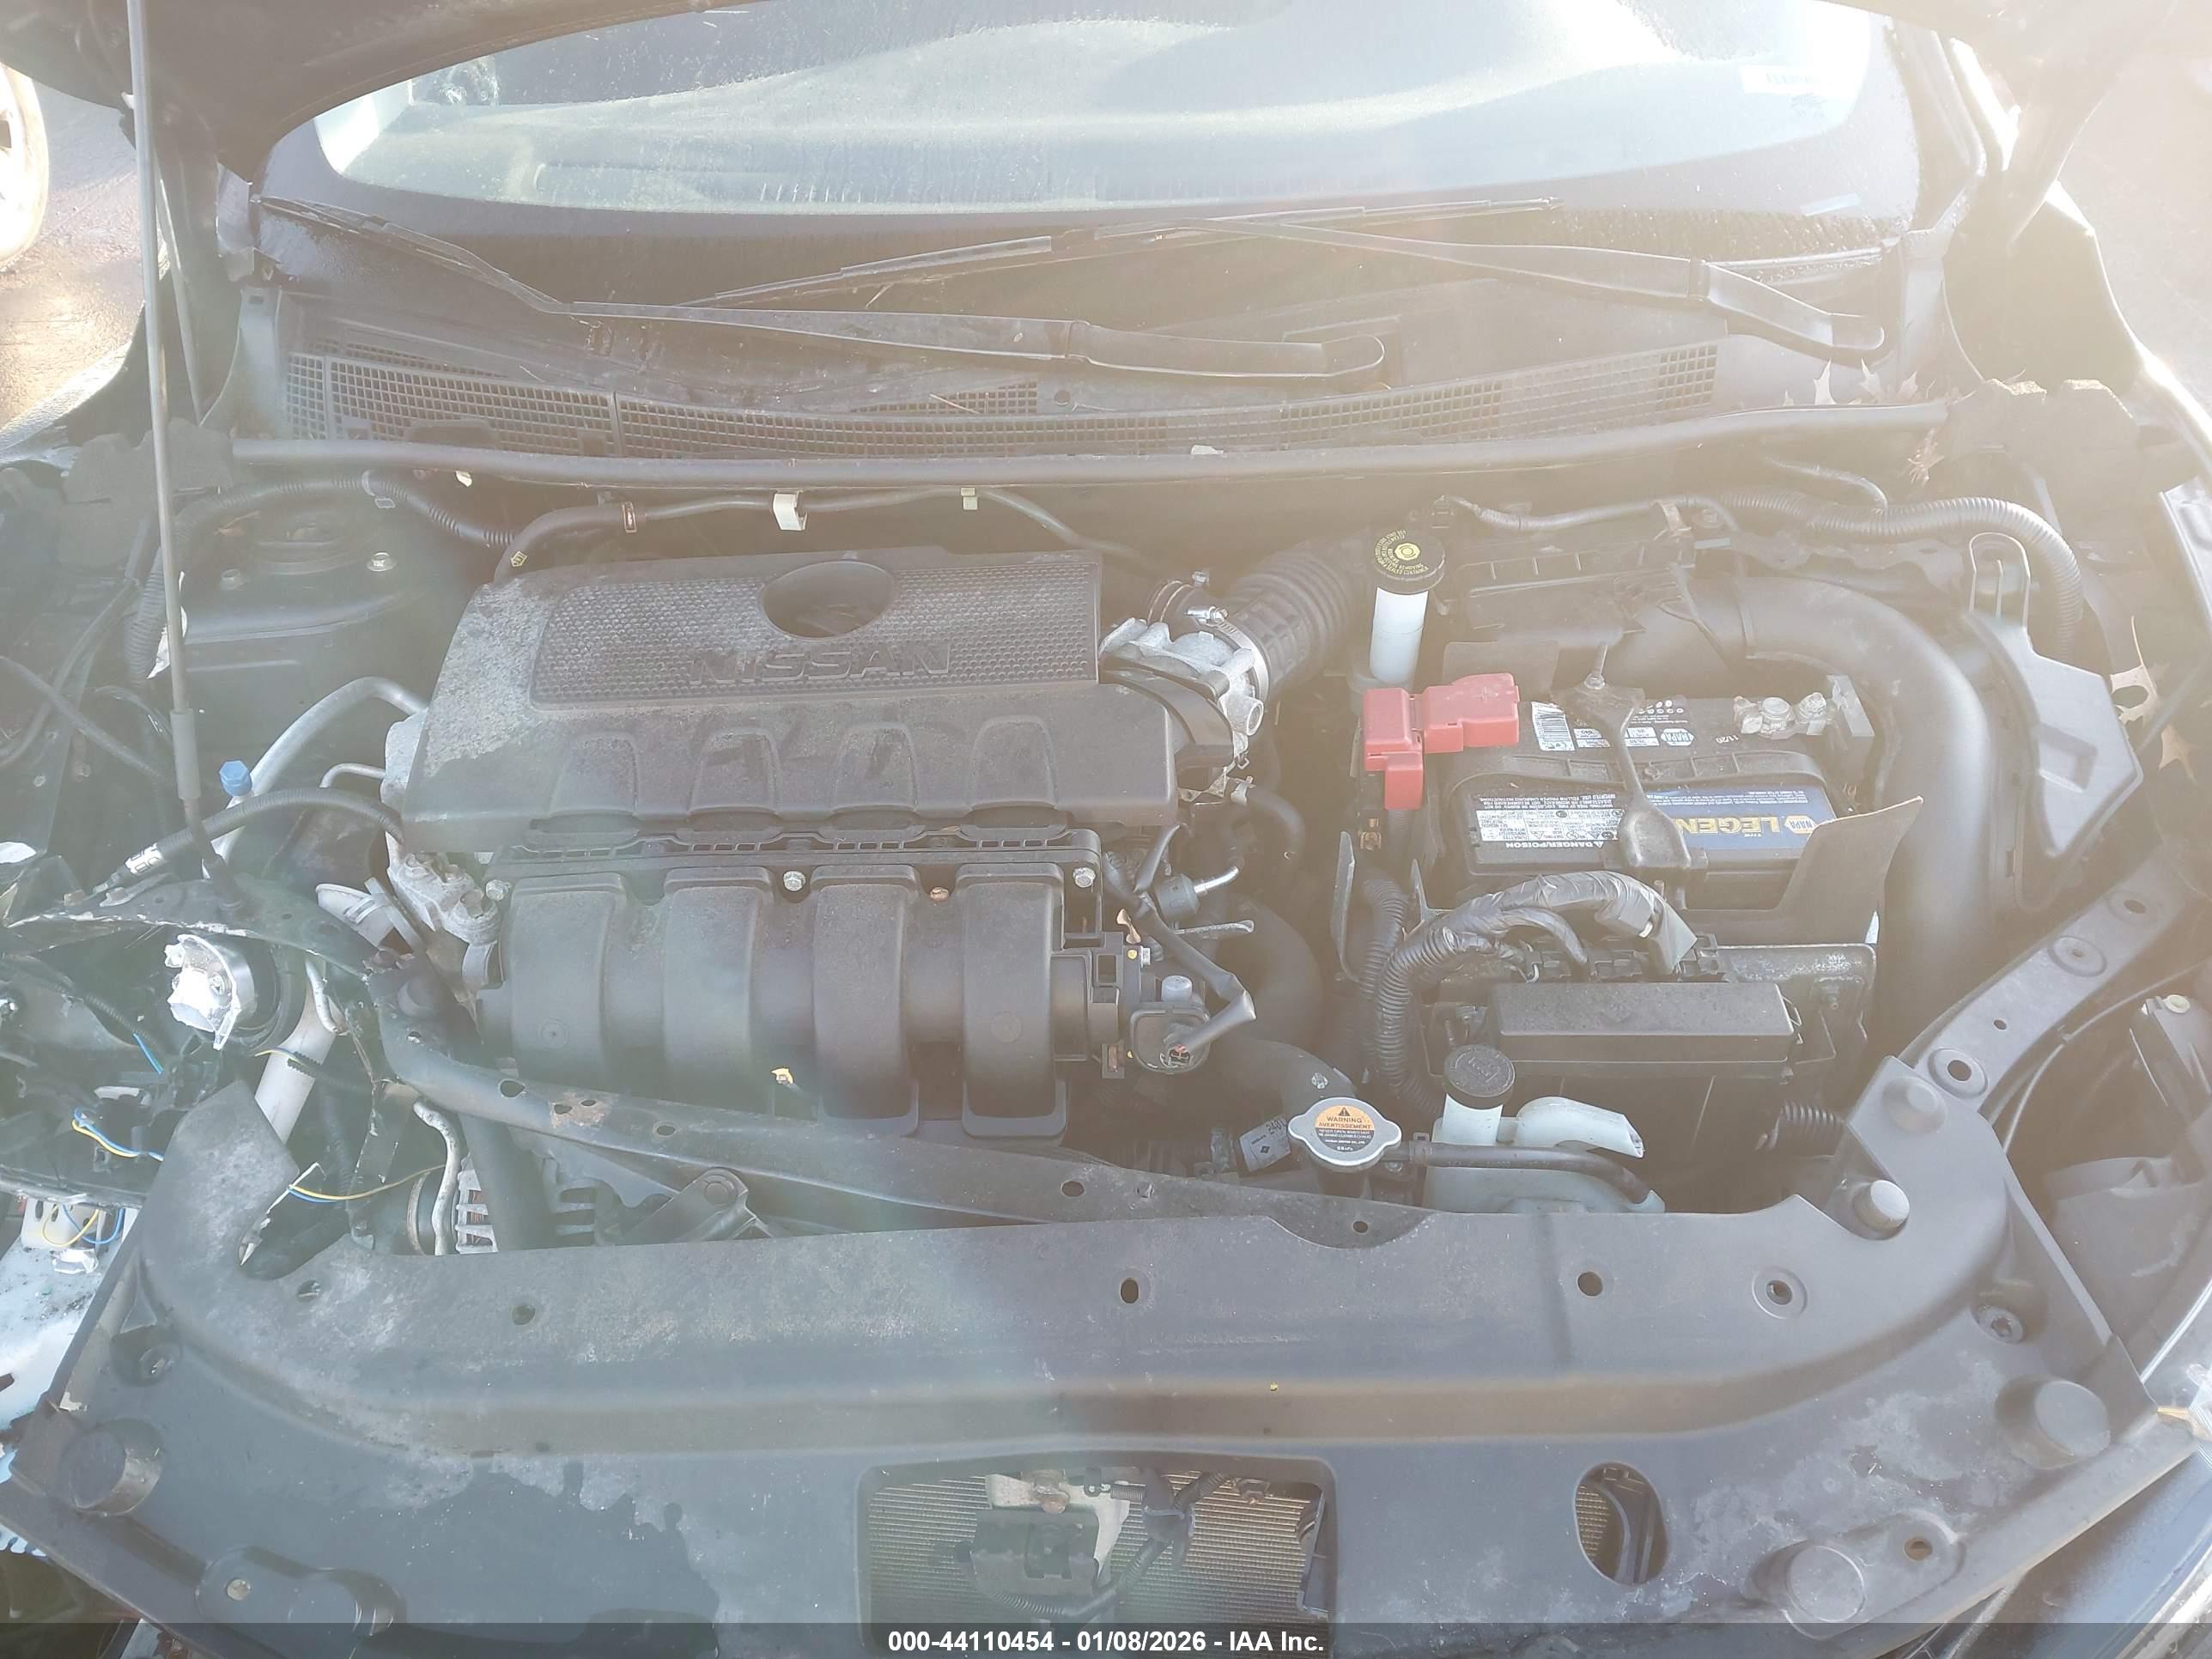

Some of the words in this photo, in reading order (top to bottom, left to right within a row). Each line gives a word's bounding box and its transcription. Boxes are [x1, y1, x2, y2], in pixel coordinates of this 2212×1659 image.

[690, 645, 951, 684] NISSAN
[1665, 732, 1689, 742] NAPA
[1671, 817, 1780, 834] LEGEN
[1789, 820, 1813, 829] NAPA
